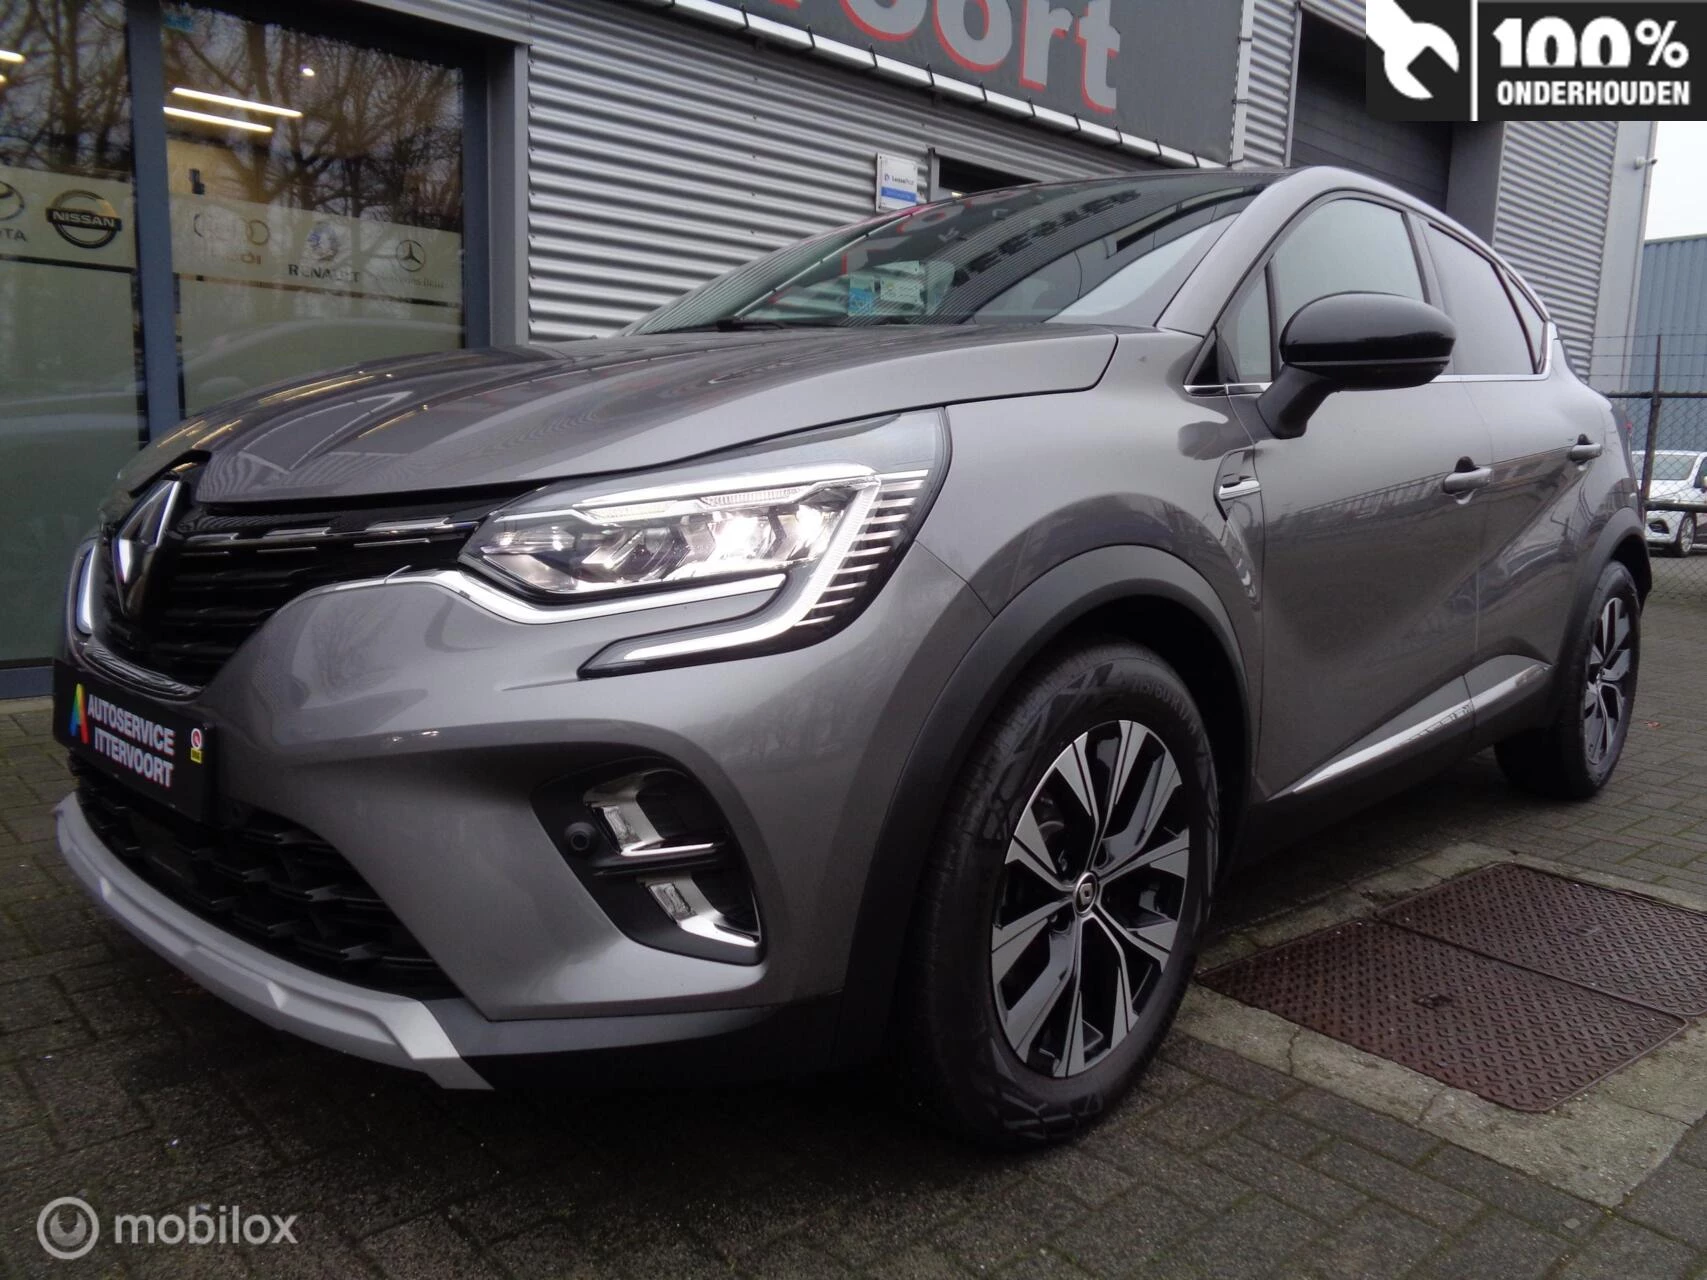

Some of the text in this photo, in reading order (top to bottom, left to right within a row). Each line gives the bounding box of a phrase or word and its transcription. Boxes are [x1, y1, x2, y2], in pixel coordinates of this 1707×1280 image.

[52, 211, 115, 228] NISSAN
[0, 227, 27, 242] TA
[288, 263, 361, 283] RNAT
[87, 693, 176, 756] AUTOSERVICE
[94, 725, 175, 788] ITTERVOORT
